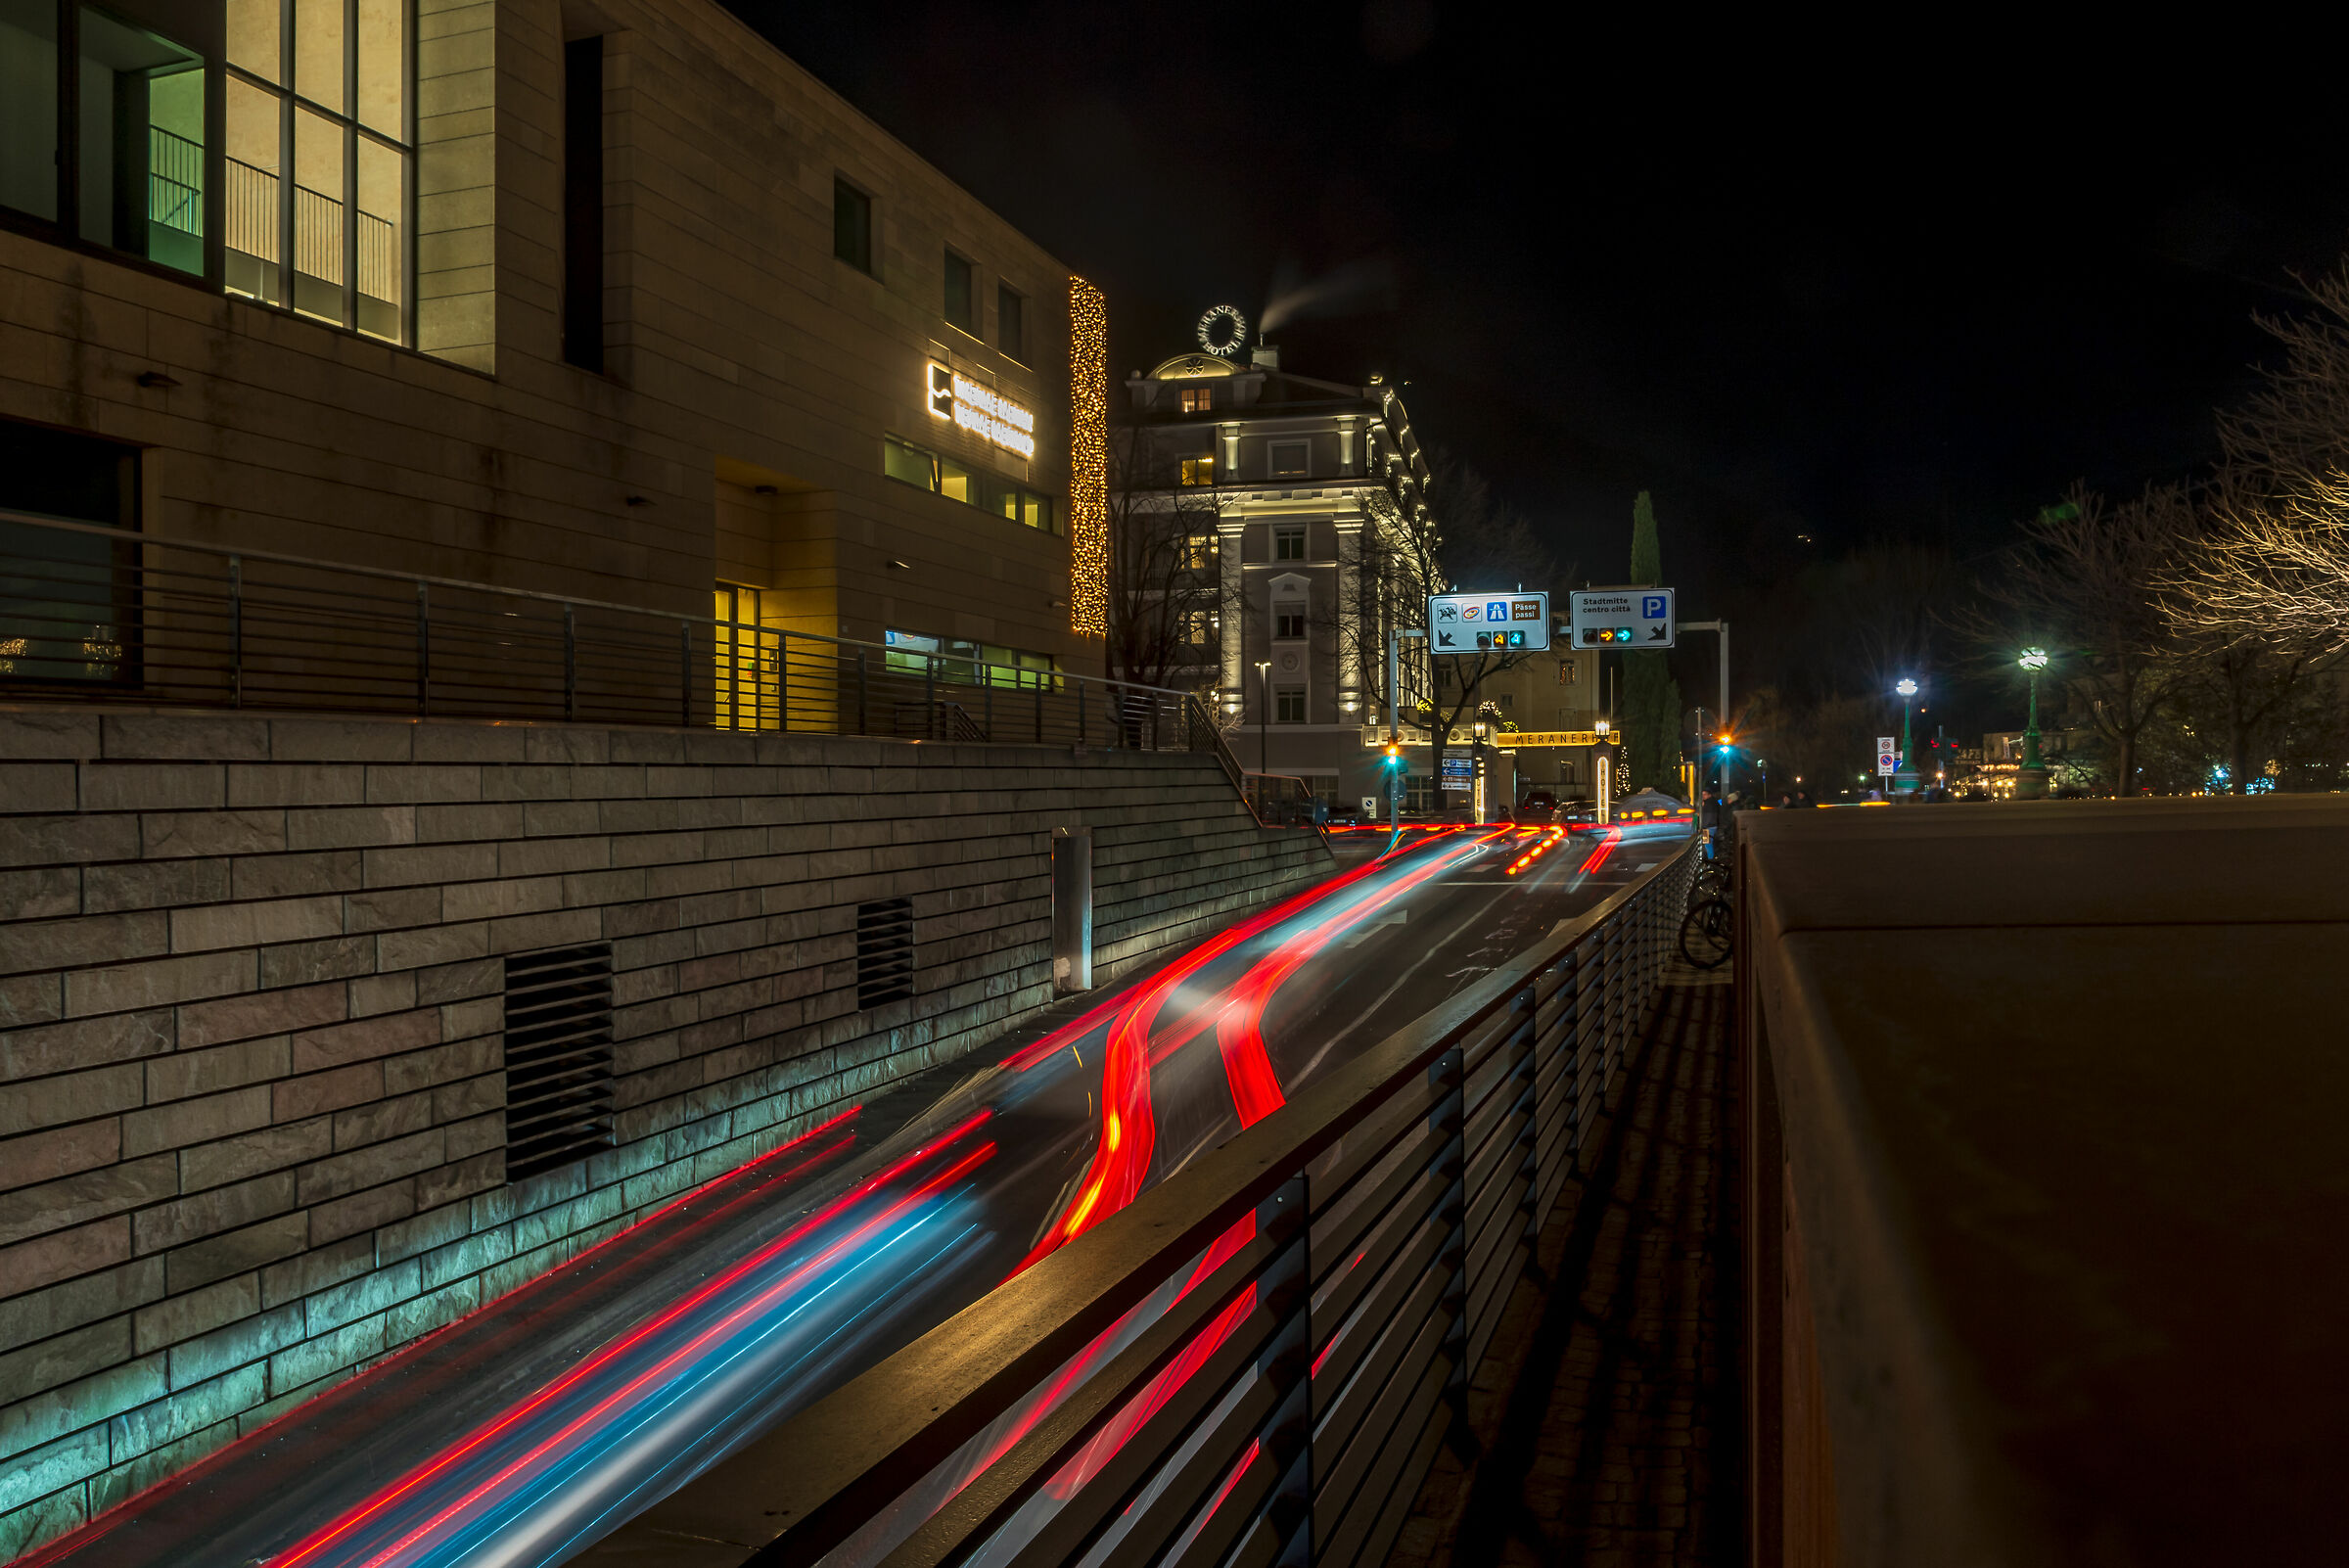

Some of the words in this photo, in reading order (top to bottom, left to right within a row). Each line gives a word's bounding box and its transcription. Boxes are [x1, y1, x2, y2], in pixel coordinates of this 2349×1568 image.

[1202, 341, 1241, 356] HOTEL
[1647, 599, 1661, 617] P
[1516, 734, 1619, 744] MERANERHF
